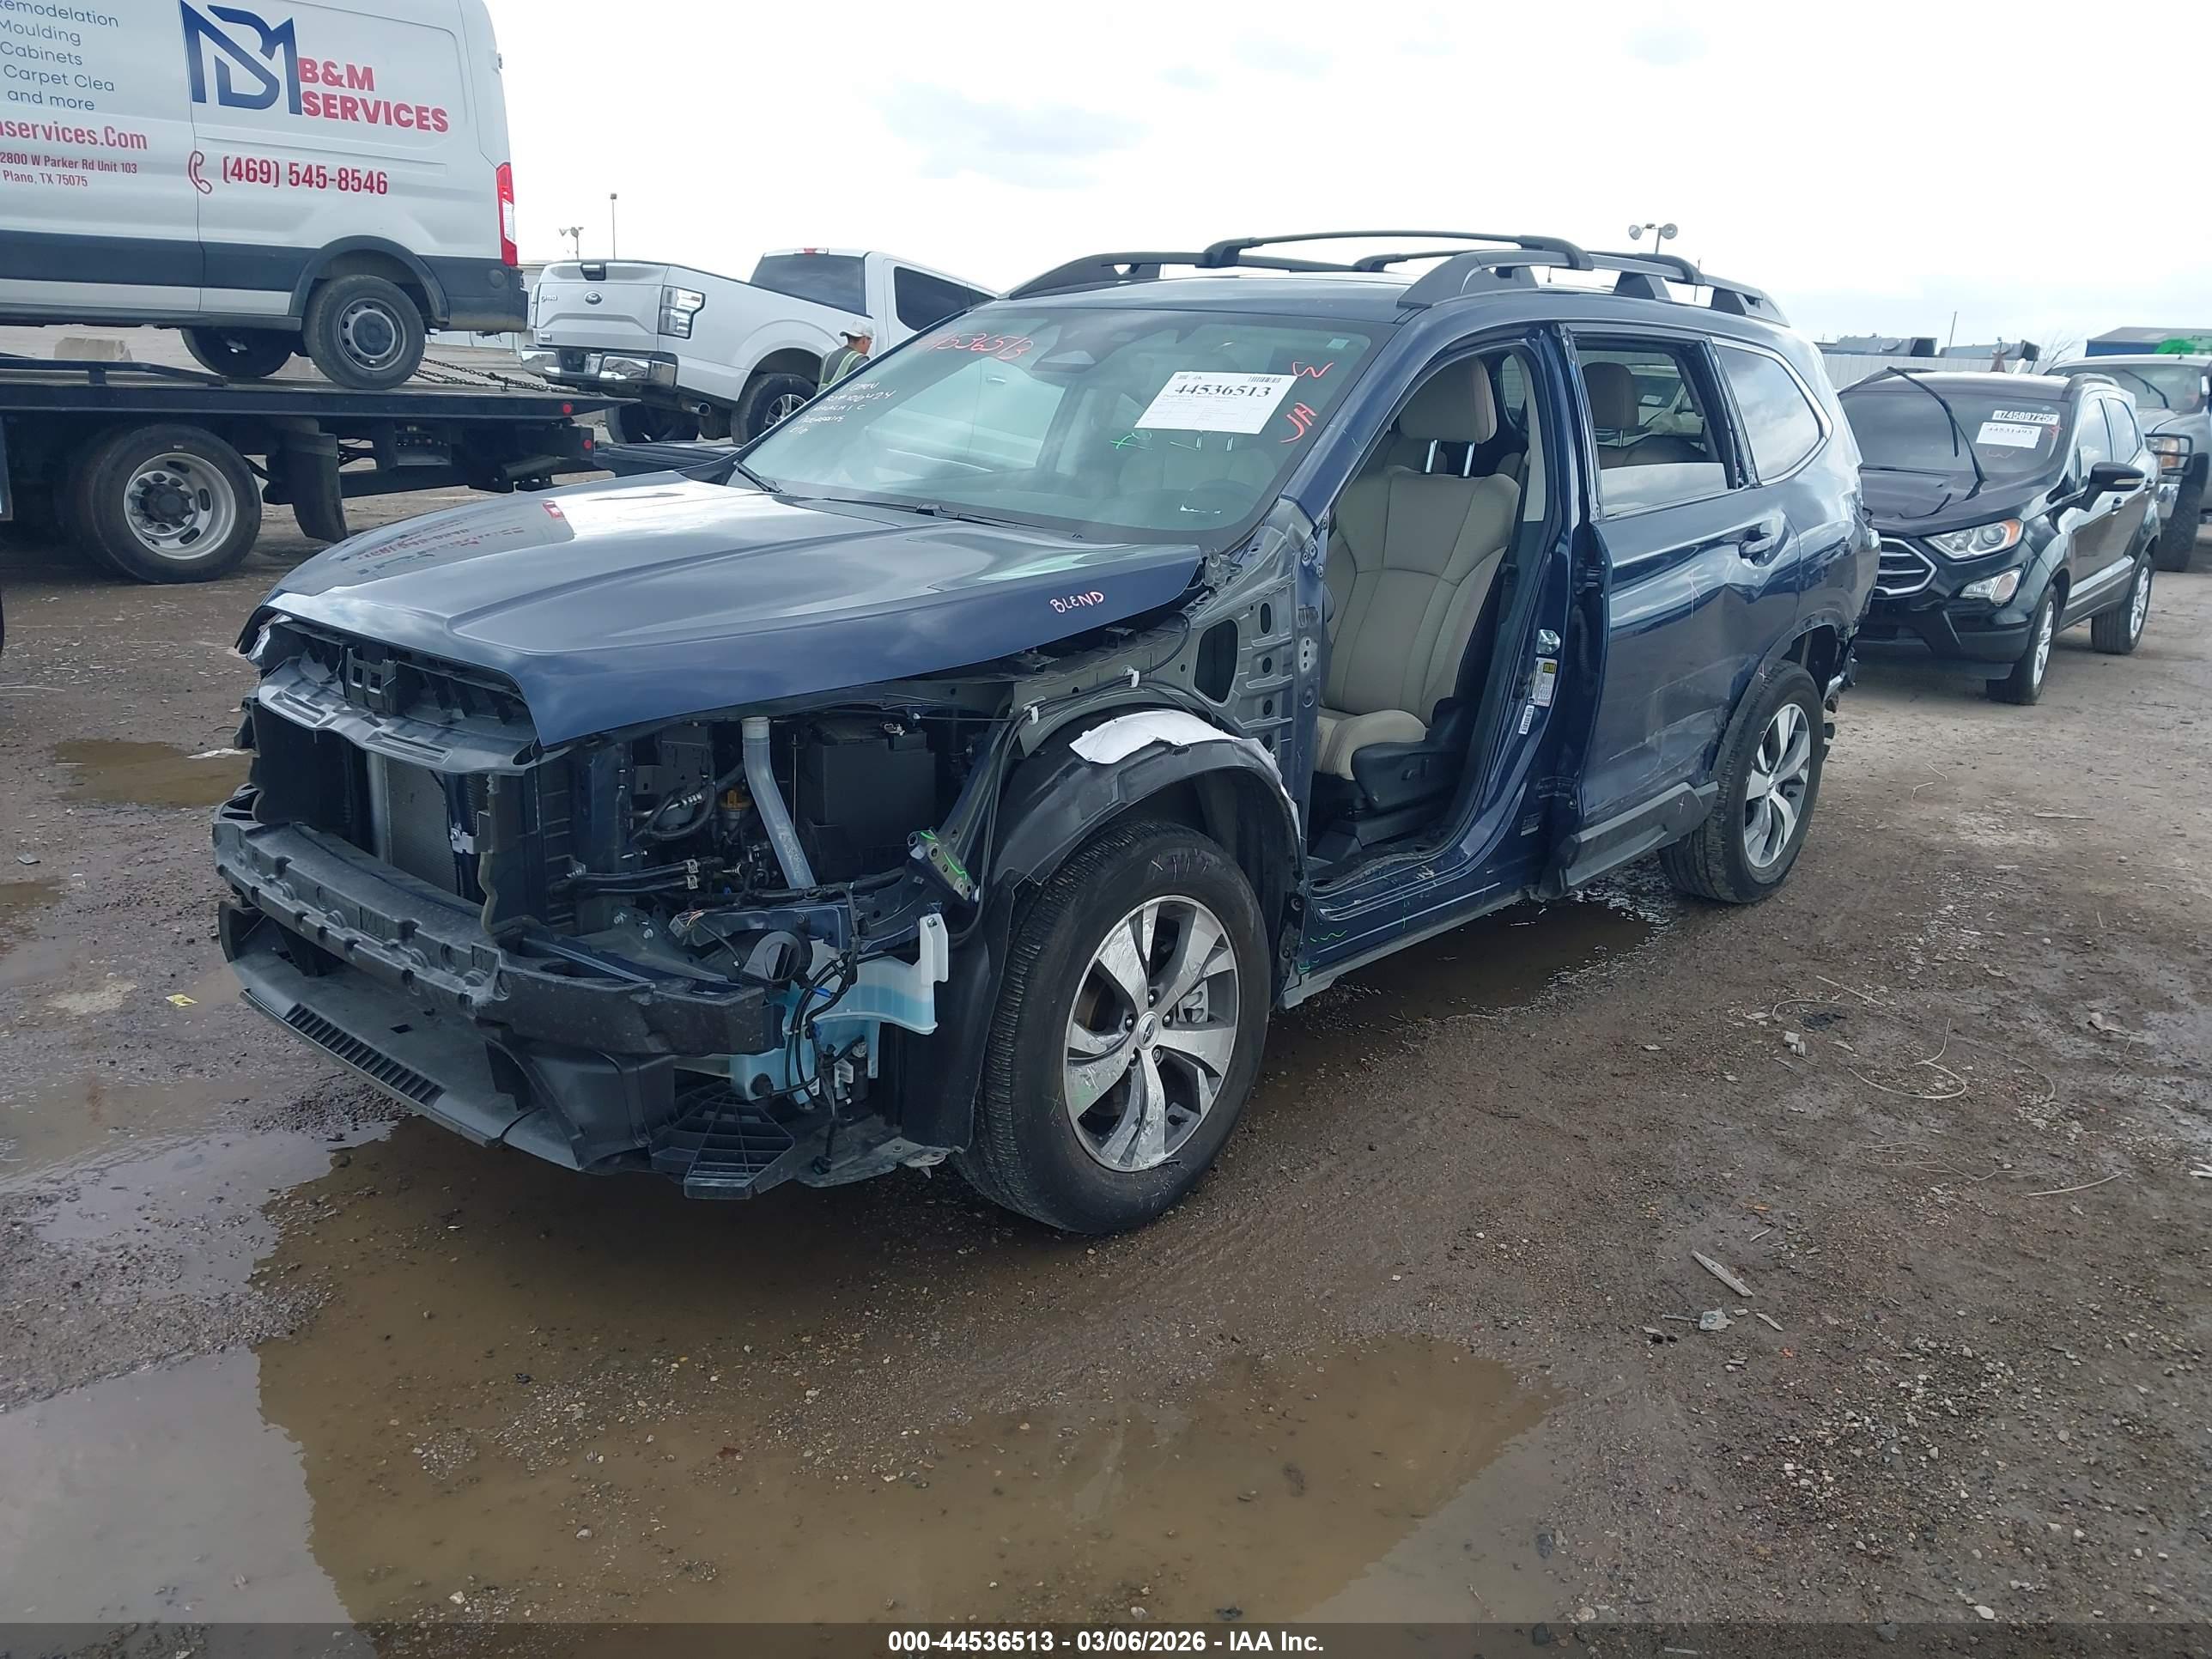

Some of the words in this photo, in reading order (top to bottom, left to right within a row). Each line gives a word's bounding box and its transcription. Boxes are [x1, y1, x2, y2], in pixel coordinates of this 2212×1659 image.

[0, 20, 81, 46] Moulding
[0, 41, 82, 65] Cabinets
[3, 64, 69, 85] Carpet
[75, 75, 114, 91] Clea
[298, 57, 374, 92] B&M
[8, 89, 43, 104] and
[50, 95, 94, 110] more
[302, 90, 448, 132] SERVICES
[0, 152, 27, 165] 2800
[31, 155, 40, 166] W
[45, 155, 78, 169] Parker
[82, 159, 94, 170] Rd
[98, 161, 117, 172] Unit
[121, 162, 137, 173] 103
[40, 173, 53, 184] TX
[57, 174, 88, 186] 75075
[222, 155, 280, 188] (469)
[288, 162, 388, 195] 545-8546
[1175, 383, 1272, 398] 44536513
[1049, 591, 1105, 614] BLEND
